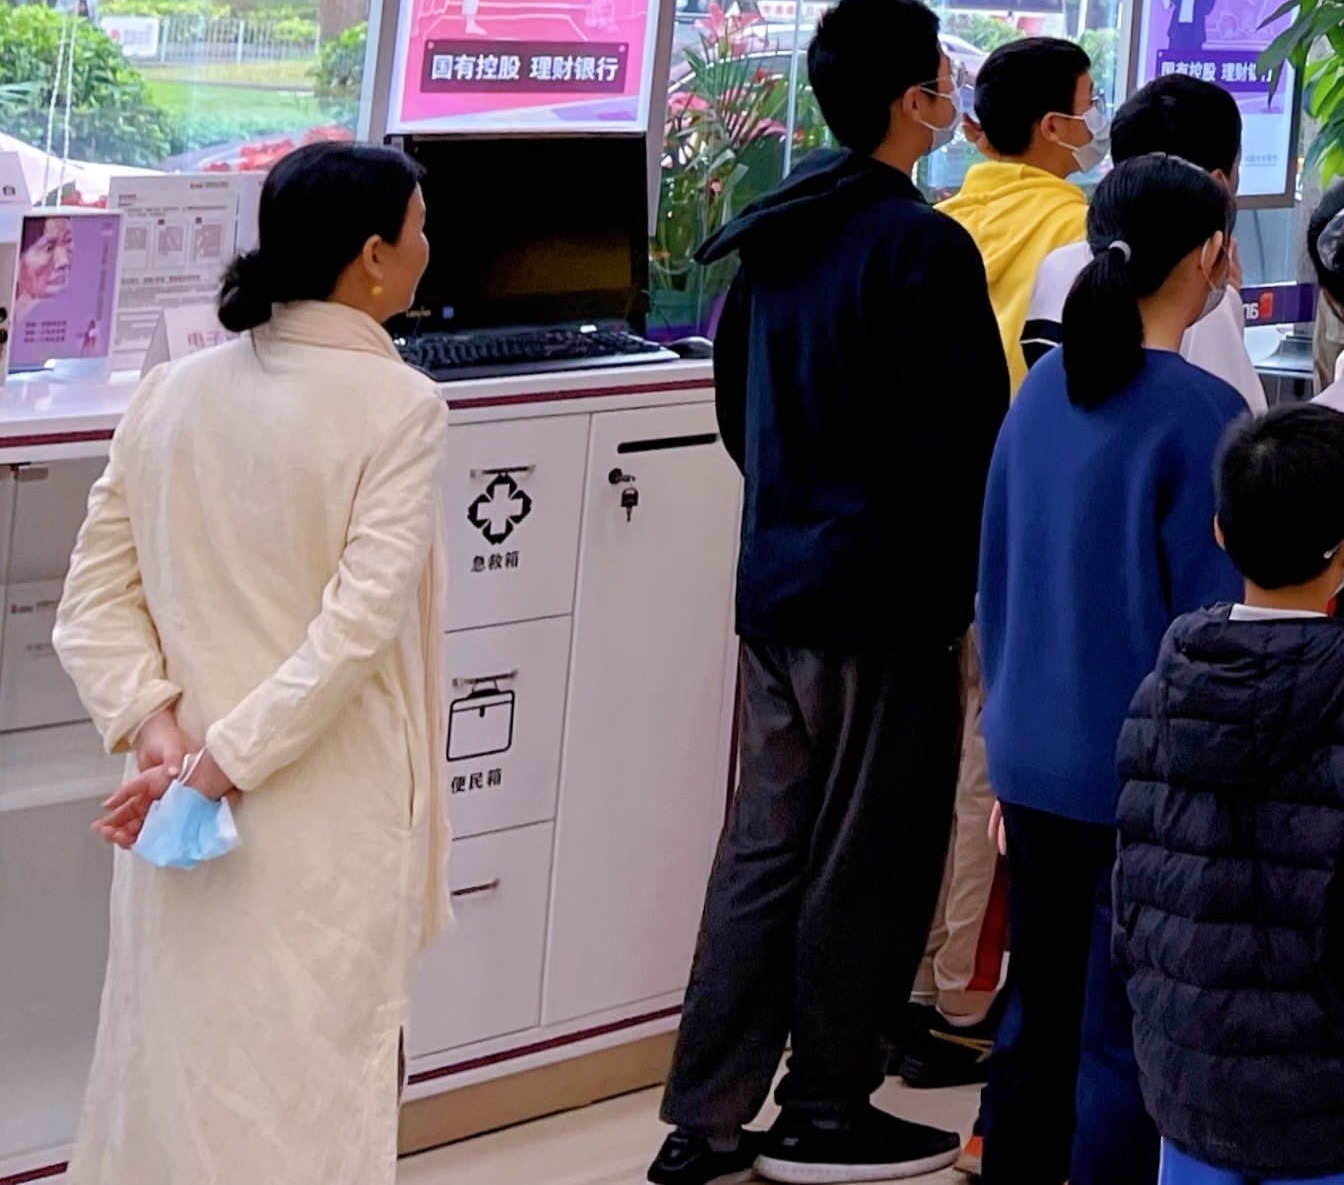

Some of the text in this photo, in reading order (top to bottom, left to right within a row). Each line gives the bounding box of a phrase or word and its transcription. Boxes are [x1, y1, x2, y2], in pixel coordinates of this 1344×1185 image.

[431, 54, 619, 83] 国有控股 理财银行
[470, 551, 520, 573] 急救箱
[450, 768, 503, 794] 便民箱
